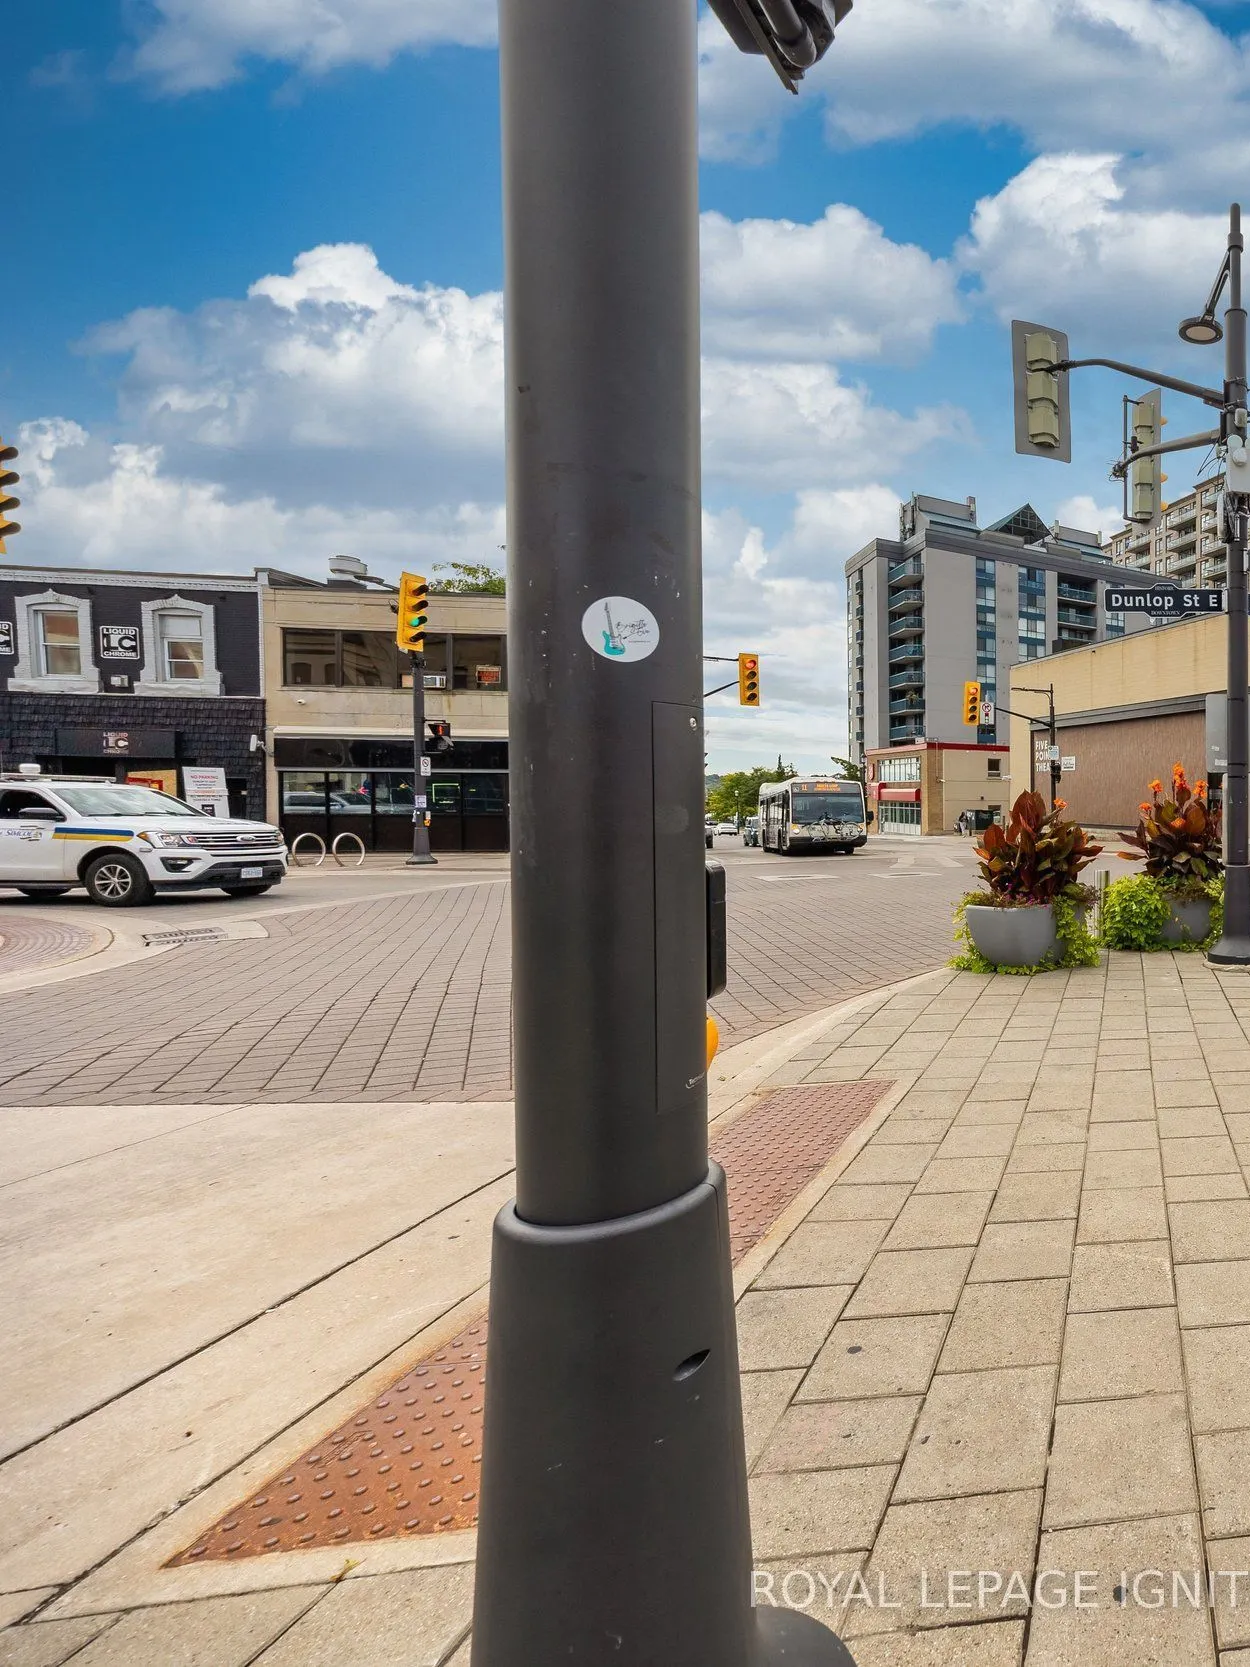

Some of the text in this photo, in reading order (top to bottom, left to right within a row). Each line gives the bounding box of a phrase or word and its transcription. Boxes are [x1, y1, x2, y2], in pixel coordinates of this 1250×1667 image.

[1111, 593, 1218, 610] Dunlop St E
[1035, 740, 1048, 750] FIVE
